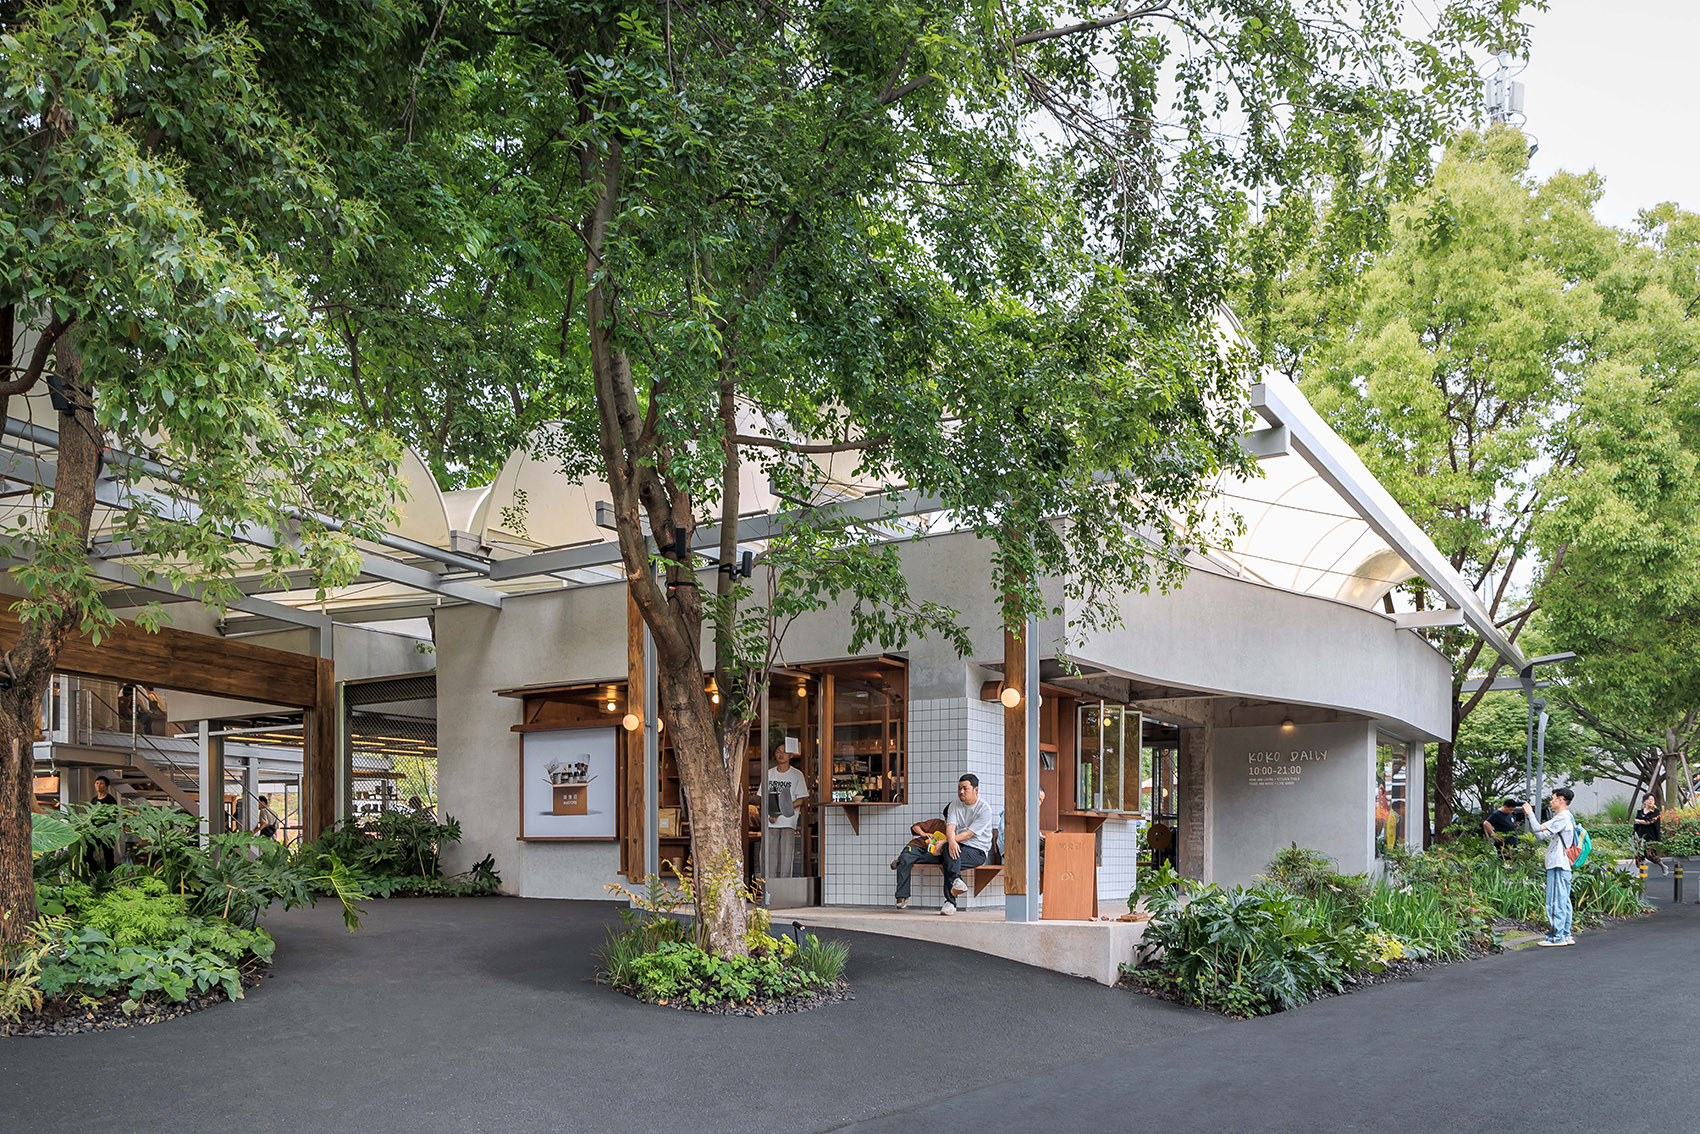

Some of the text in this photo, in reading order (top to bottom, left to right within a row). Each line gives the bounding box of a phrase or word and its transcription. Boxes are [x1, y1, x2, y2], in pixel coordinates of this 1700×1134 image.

[1249, 750, 1327, 763] KOKO DAILY
[1249, 766, 1301, 775] 10:00-21:00
